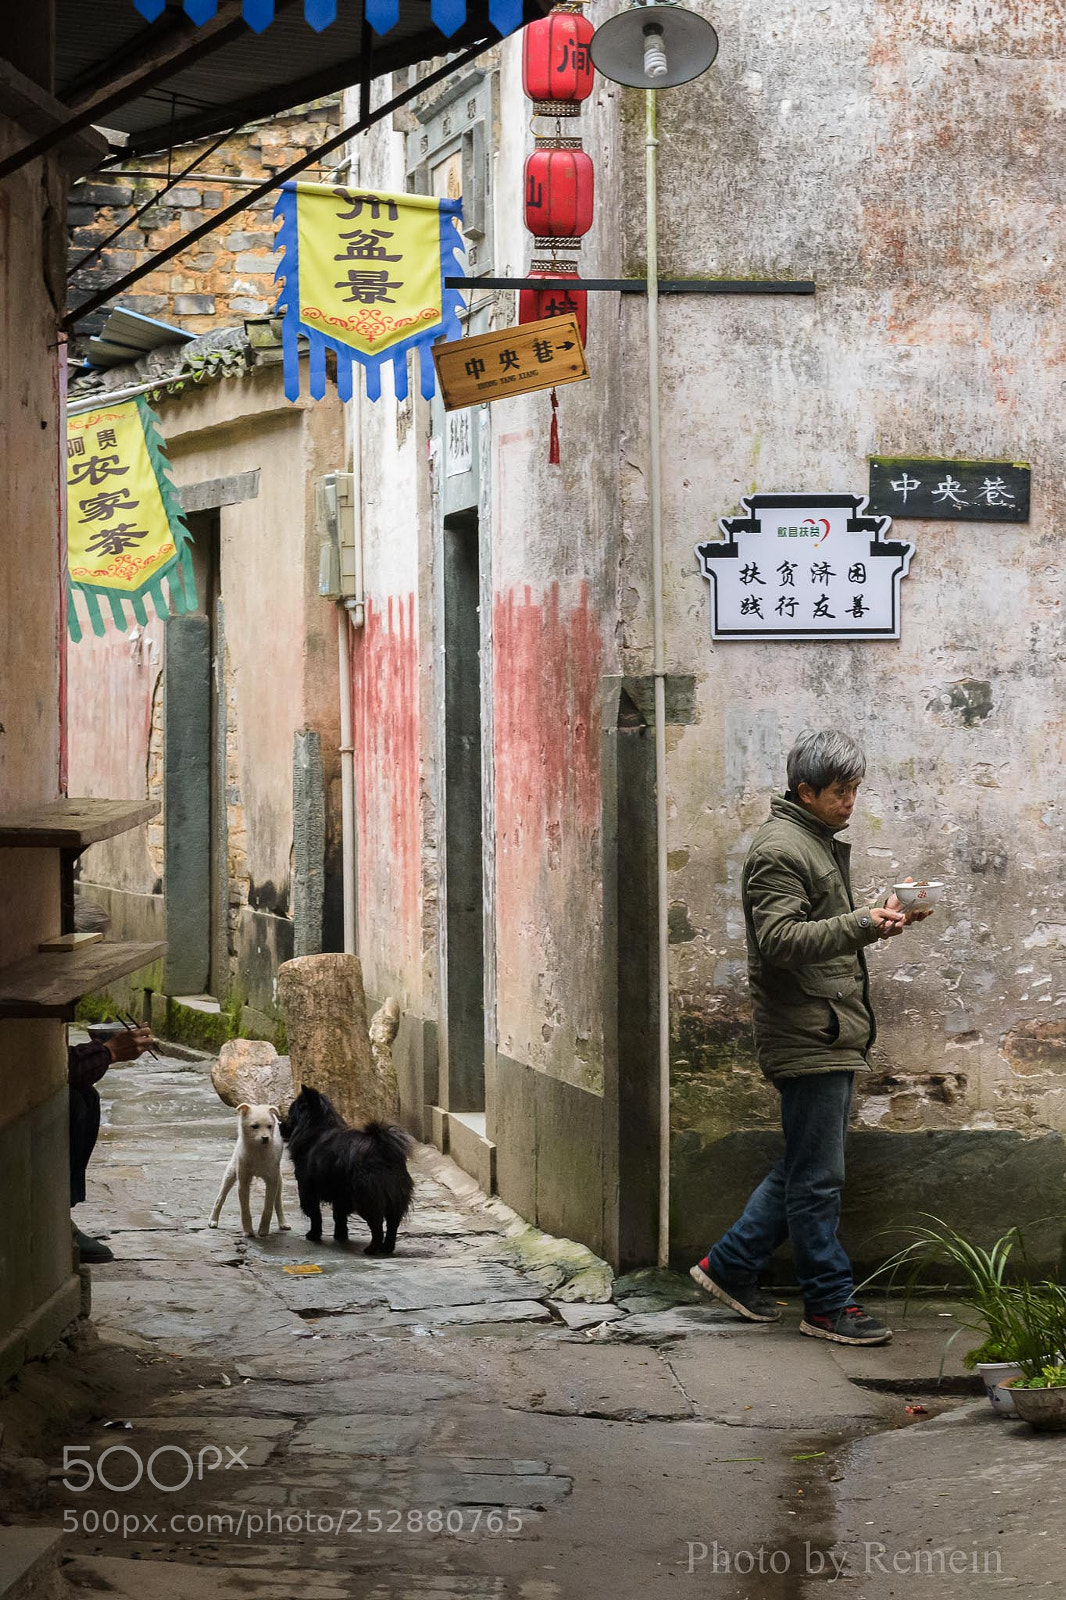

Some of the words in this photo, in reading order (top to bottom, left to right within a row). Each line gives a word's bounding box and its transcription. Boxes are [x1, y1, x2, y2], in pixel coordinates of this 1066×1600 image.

[465, 339, 554, 379] 中央巷
[67, 453, 149, 557] 农家茶
[889, 472, 1016, 506] 中央巷
[739, 560, 867, 587] 扶贫济困
[740, 593, 870, 620] 践行友善
